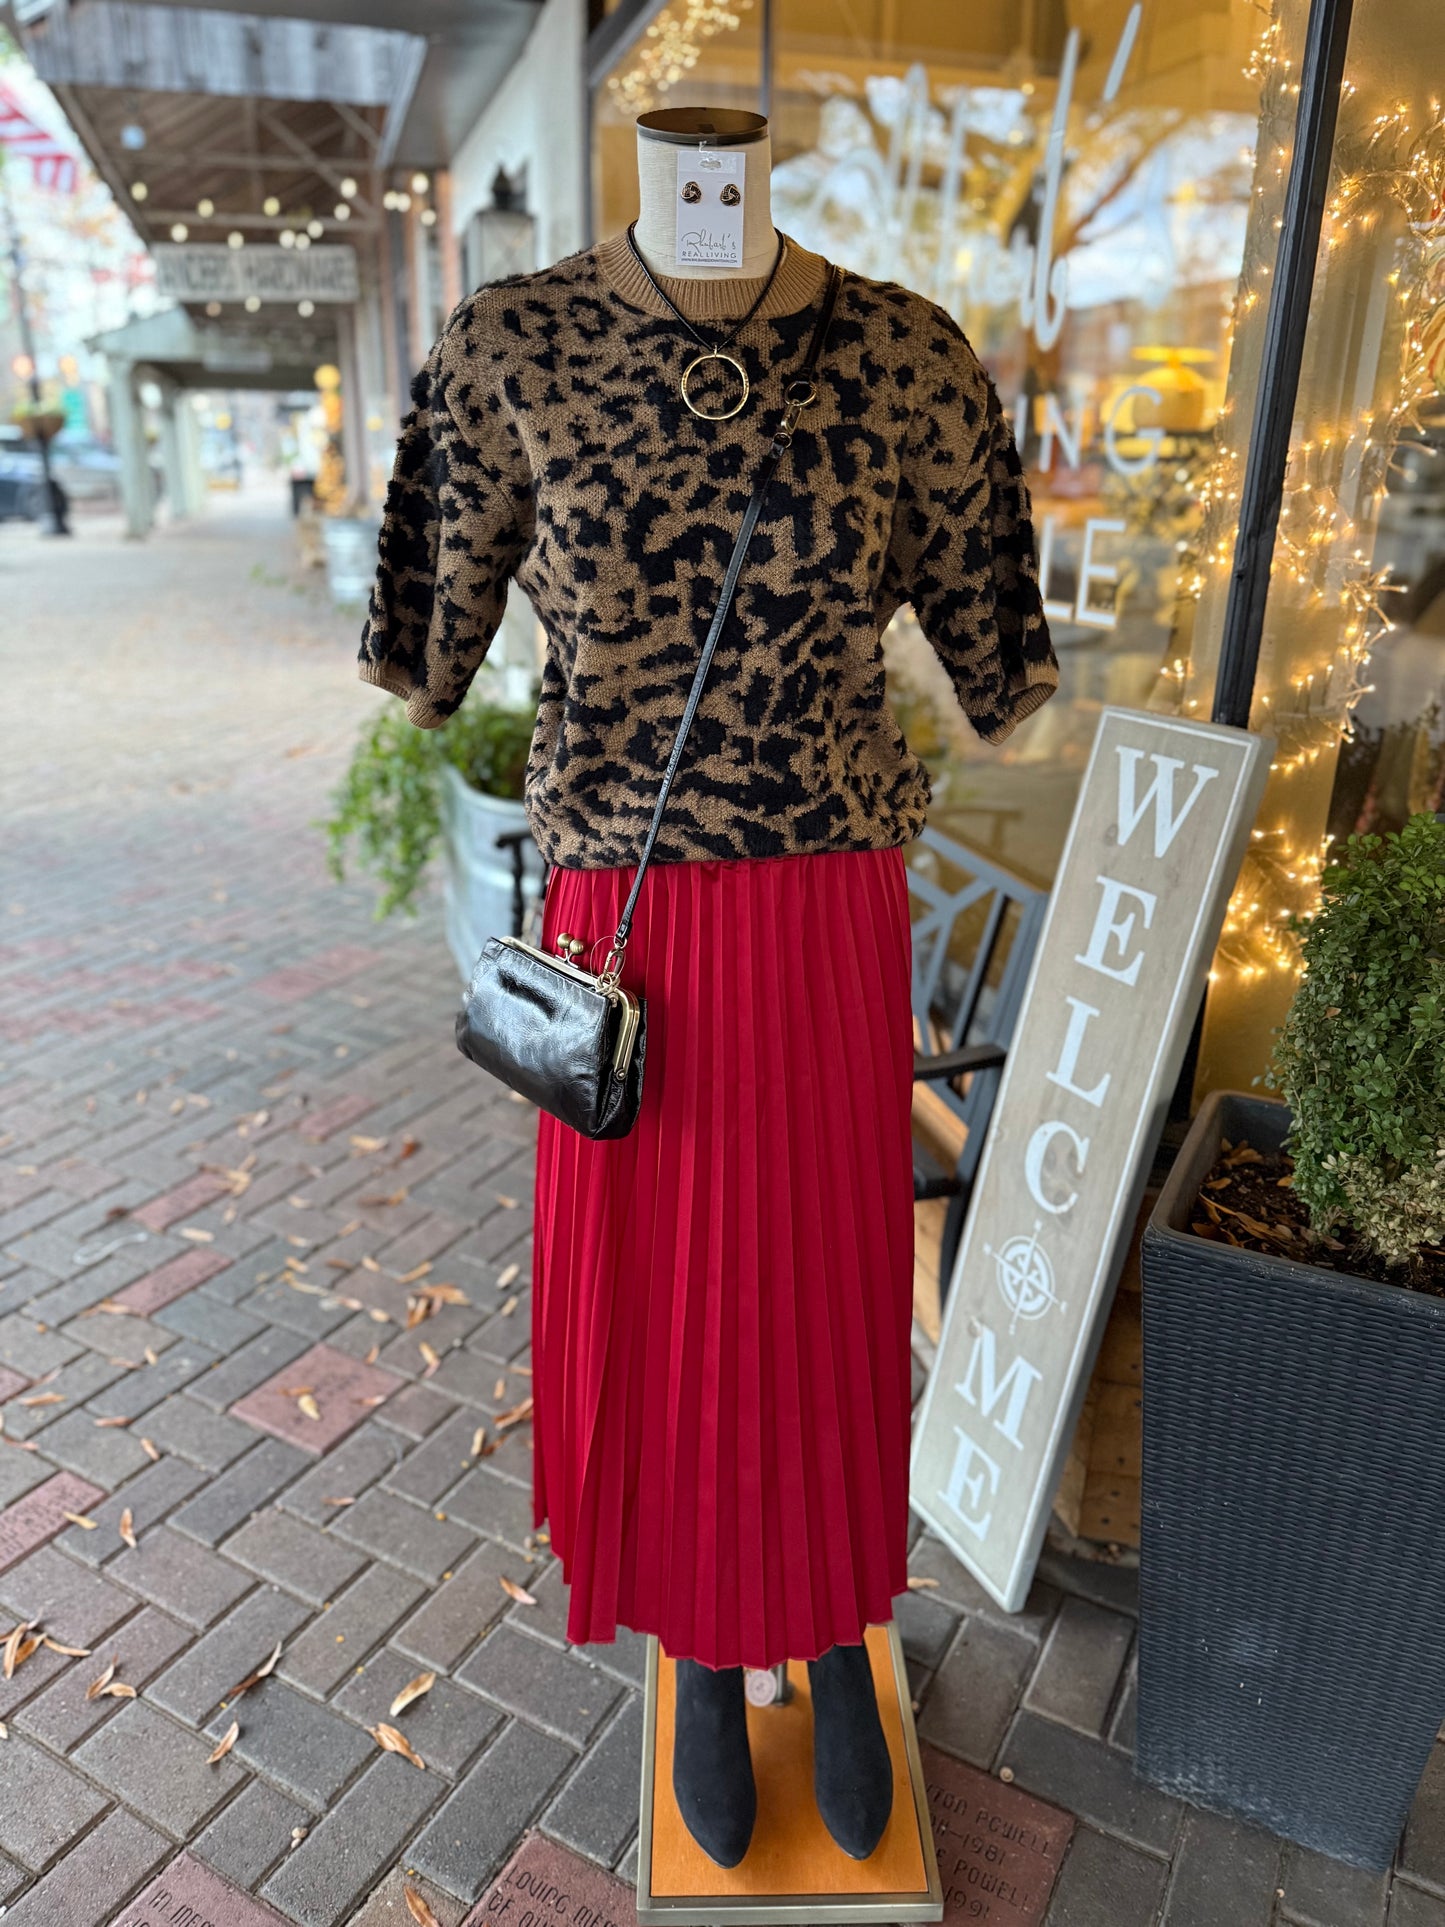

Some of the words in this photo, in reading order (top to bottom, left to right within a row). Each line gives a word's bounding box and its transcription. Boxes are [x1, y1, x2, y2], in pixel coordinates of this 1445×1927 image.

[681, 250, 703, 258] REAL
[1015, 384, 1165, 476] ING
[1039, 516, 1127, 628] LE
[926, 1783, 968, 1817] TON
[975, 1808, 1051, 1861] POWELL
[488, 1890, 515, 1917] OF
[505, 1864, 571, 1914] LOVING
[953, 1859, 1034, 1914] POWELL
